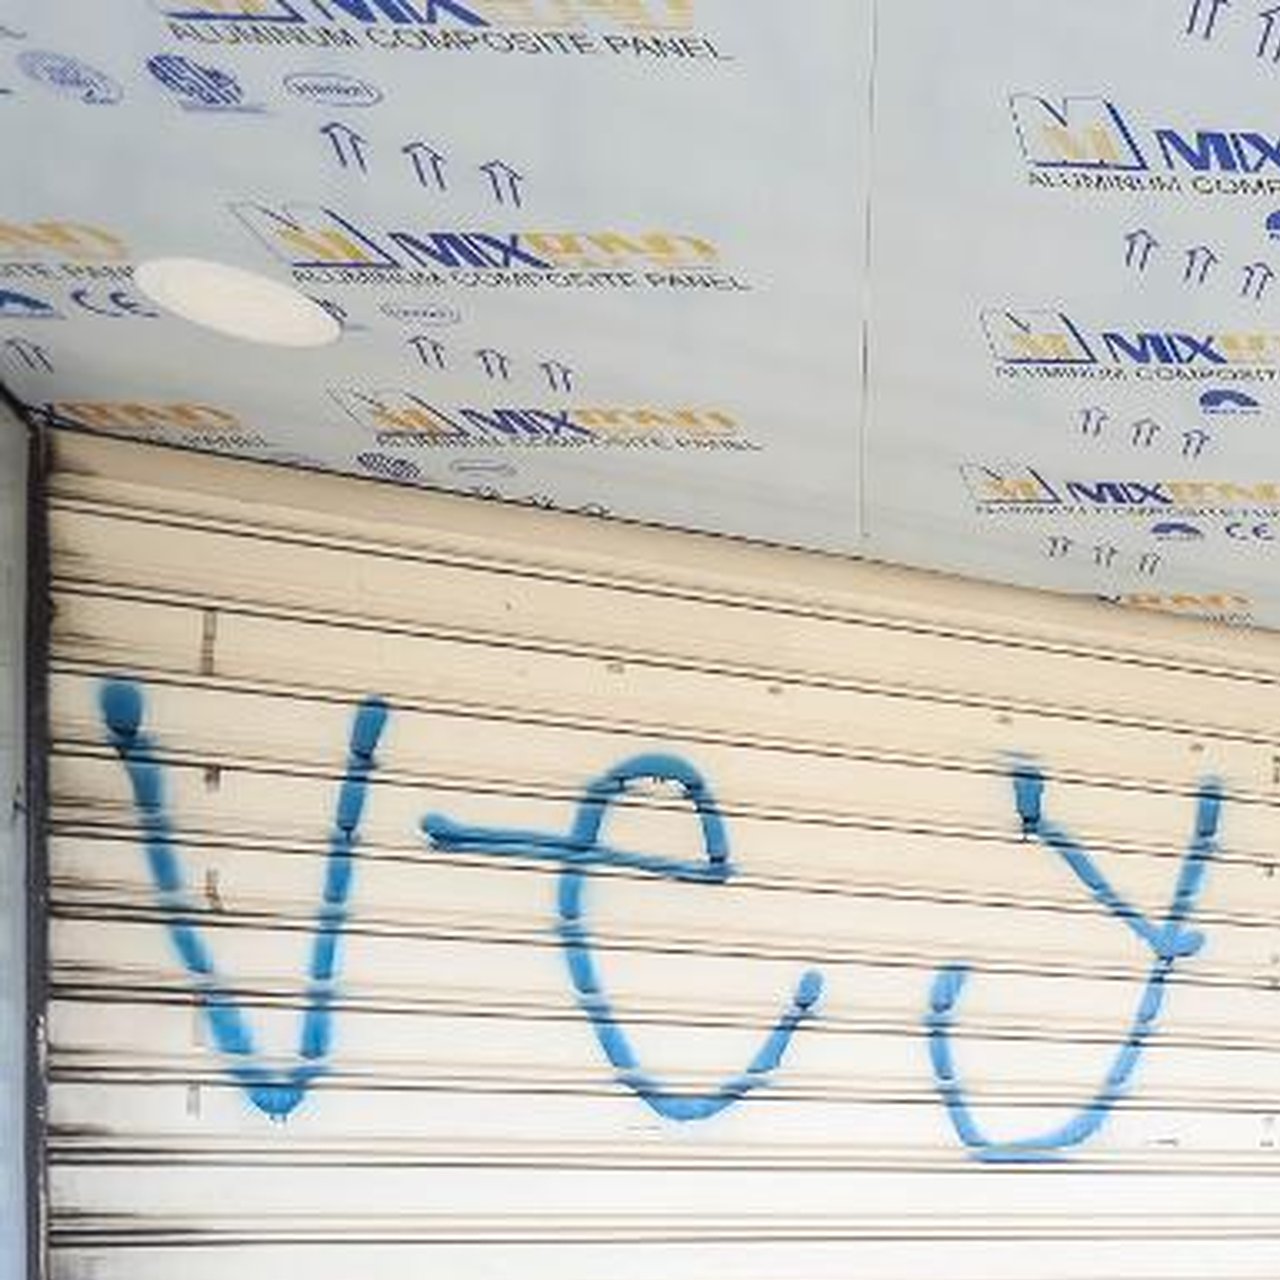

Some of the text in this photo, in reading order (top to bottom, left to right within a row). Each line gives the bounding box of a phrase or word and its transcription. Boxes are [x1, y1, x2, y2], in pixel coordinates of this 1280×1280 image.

[165, 22, 734, 60] ALUMINUM COMPOSITE PANEL
[1027, 172, 1182, 194] ALUMINUM
